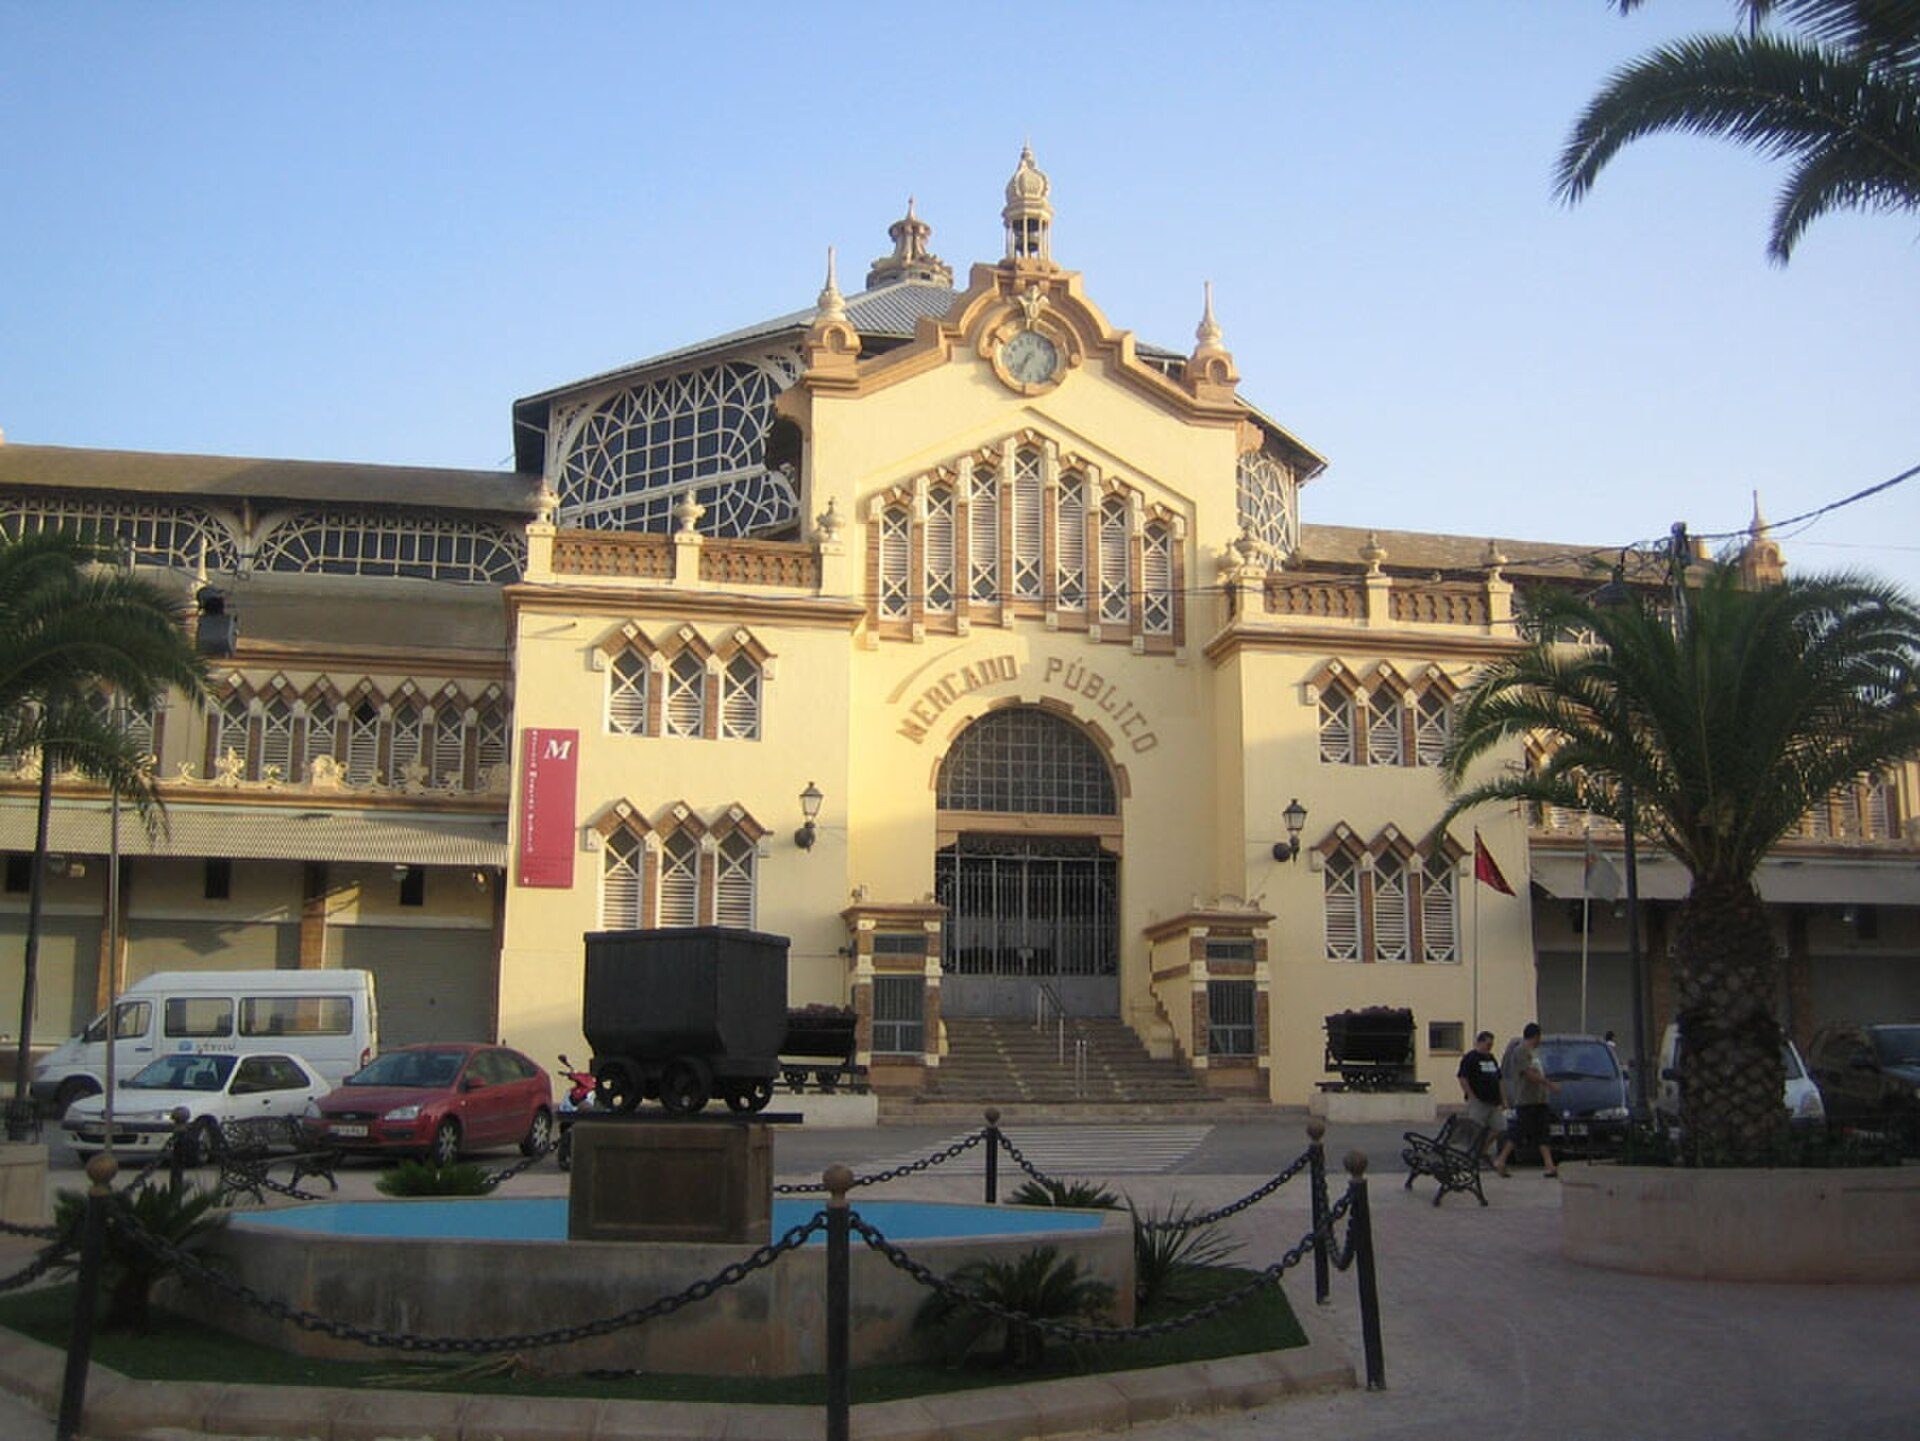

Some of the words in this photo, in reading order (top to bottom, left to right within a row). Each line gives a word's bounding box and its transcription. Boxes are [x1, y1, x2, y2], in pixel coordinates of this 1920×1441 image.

[896, 654, 1017, 744] MERCADO
[1044, 656, 1159, 753] PÚBLICO
[543, 739, 571, 760] M
